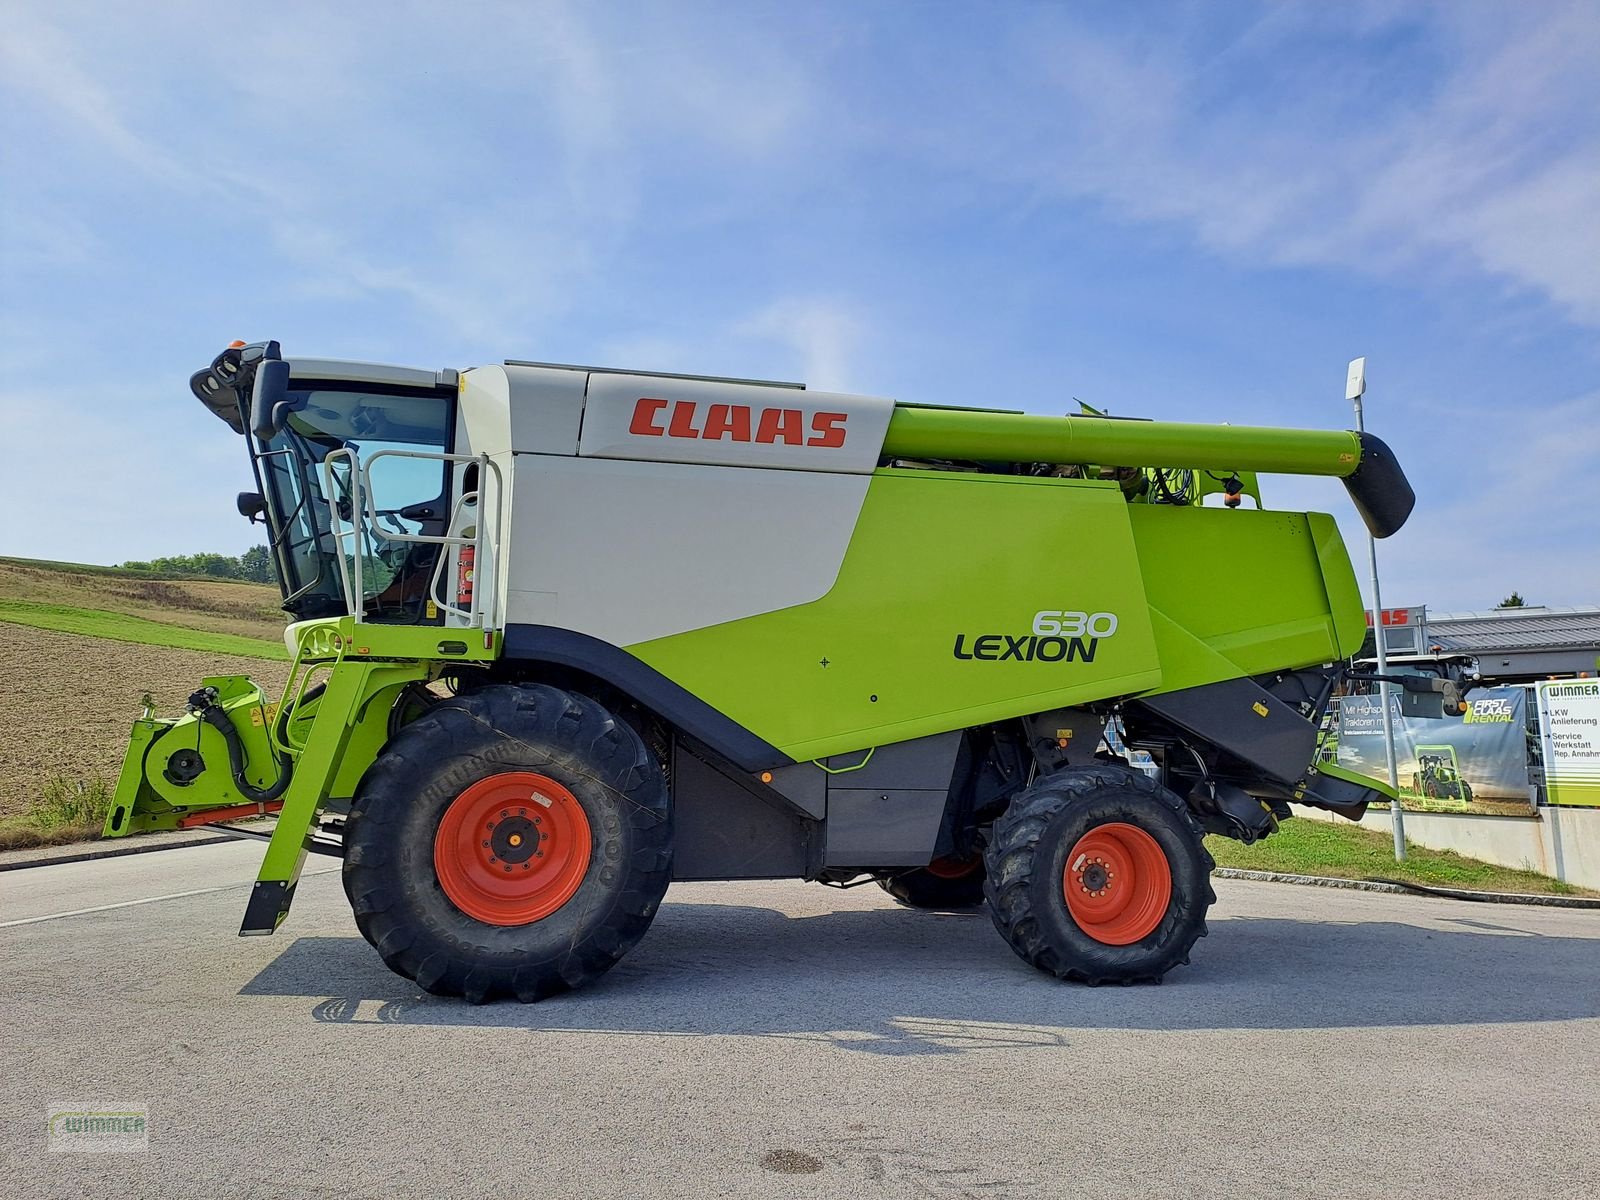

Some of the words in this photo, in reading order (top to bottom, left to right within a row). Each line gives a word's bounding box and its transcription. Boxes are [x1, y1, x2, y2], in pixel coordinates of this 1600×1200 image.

[629, 398, 848, 448] CLAAS
[1032, 610, 1118, 638] 630
[953, 634, 1098, 663] LEXION
[1549, 685, 1599, 697] WIMMER
[1474, 699, 1507, 709] FIRST
[1345, 706, 1356, 714] Mit
[1357, 704, 1396, 716] Highspd
[1473, 706, 1512, 716] CLAAS
[1549, 709, 1569, 717] LKW
[1345, 718, 1376, 727] Traktoren
[1471, 714, 1515, 724] RENTAL
[1551, 718, 1598, 727] Anlieferung
[1552, 732, 1582, 740] Service
[1553, 741, 1592, 749] Werkstatt
[1554, 750, 1570, 760] Rep.
